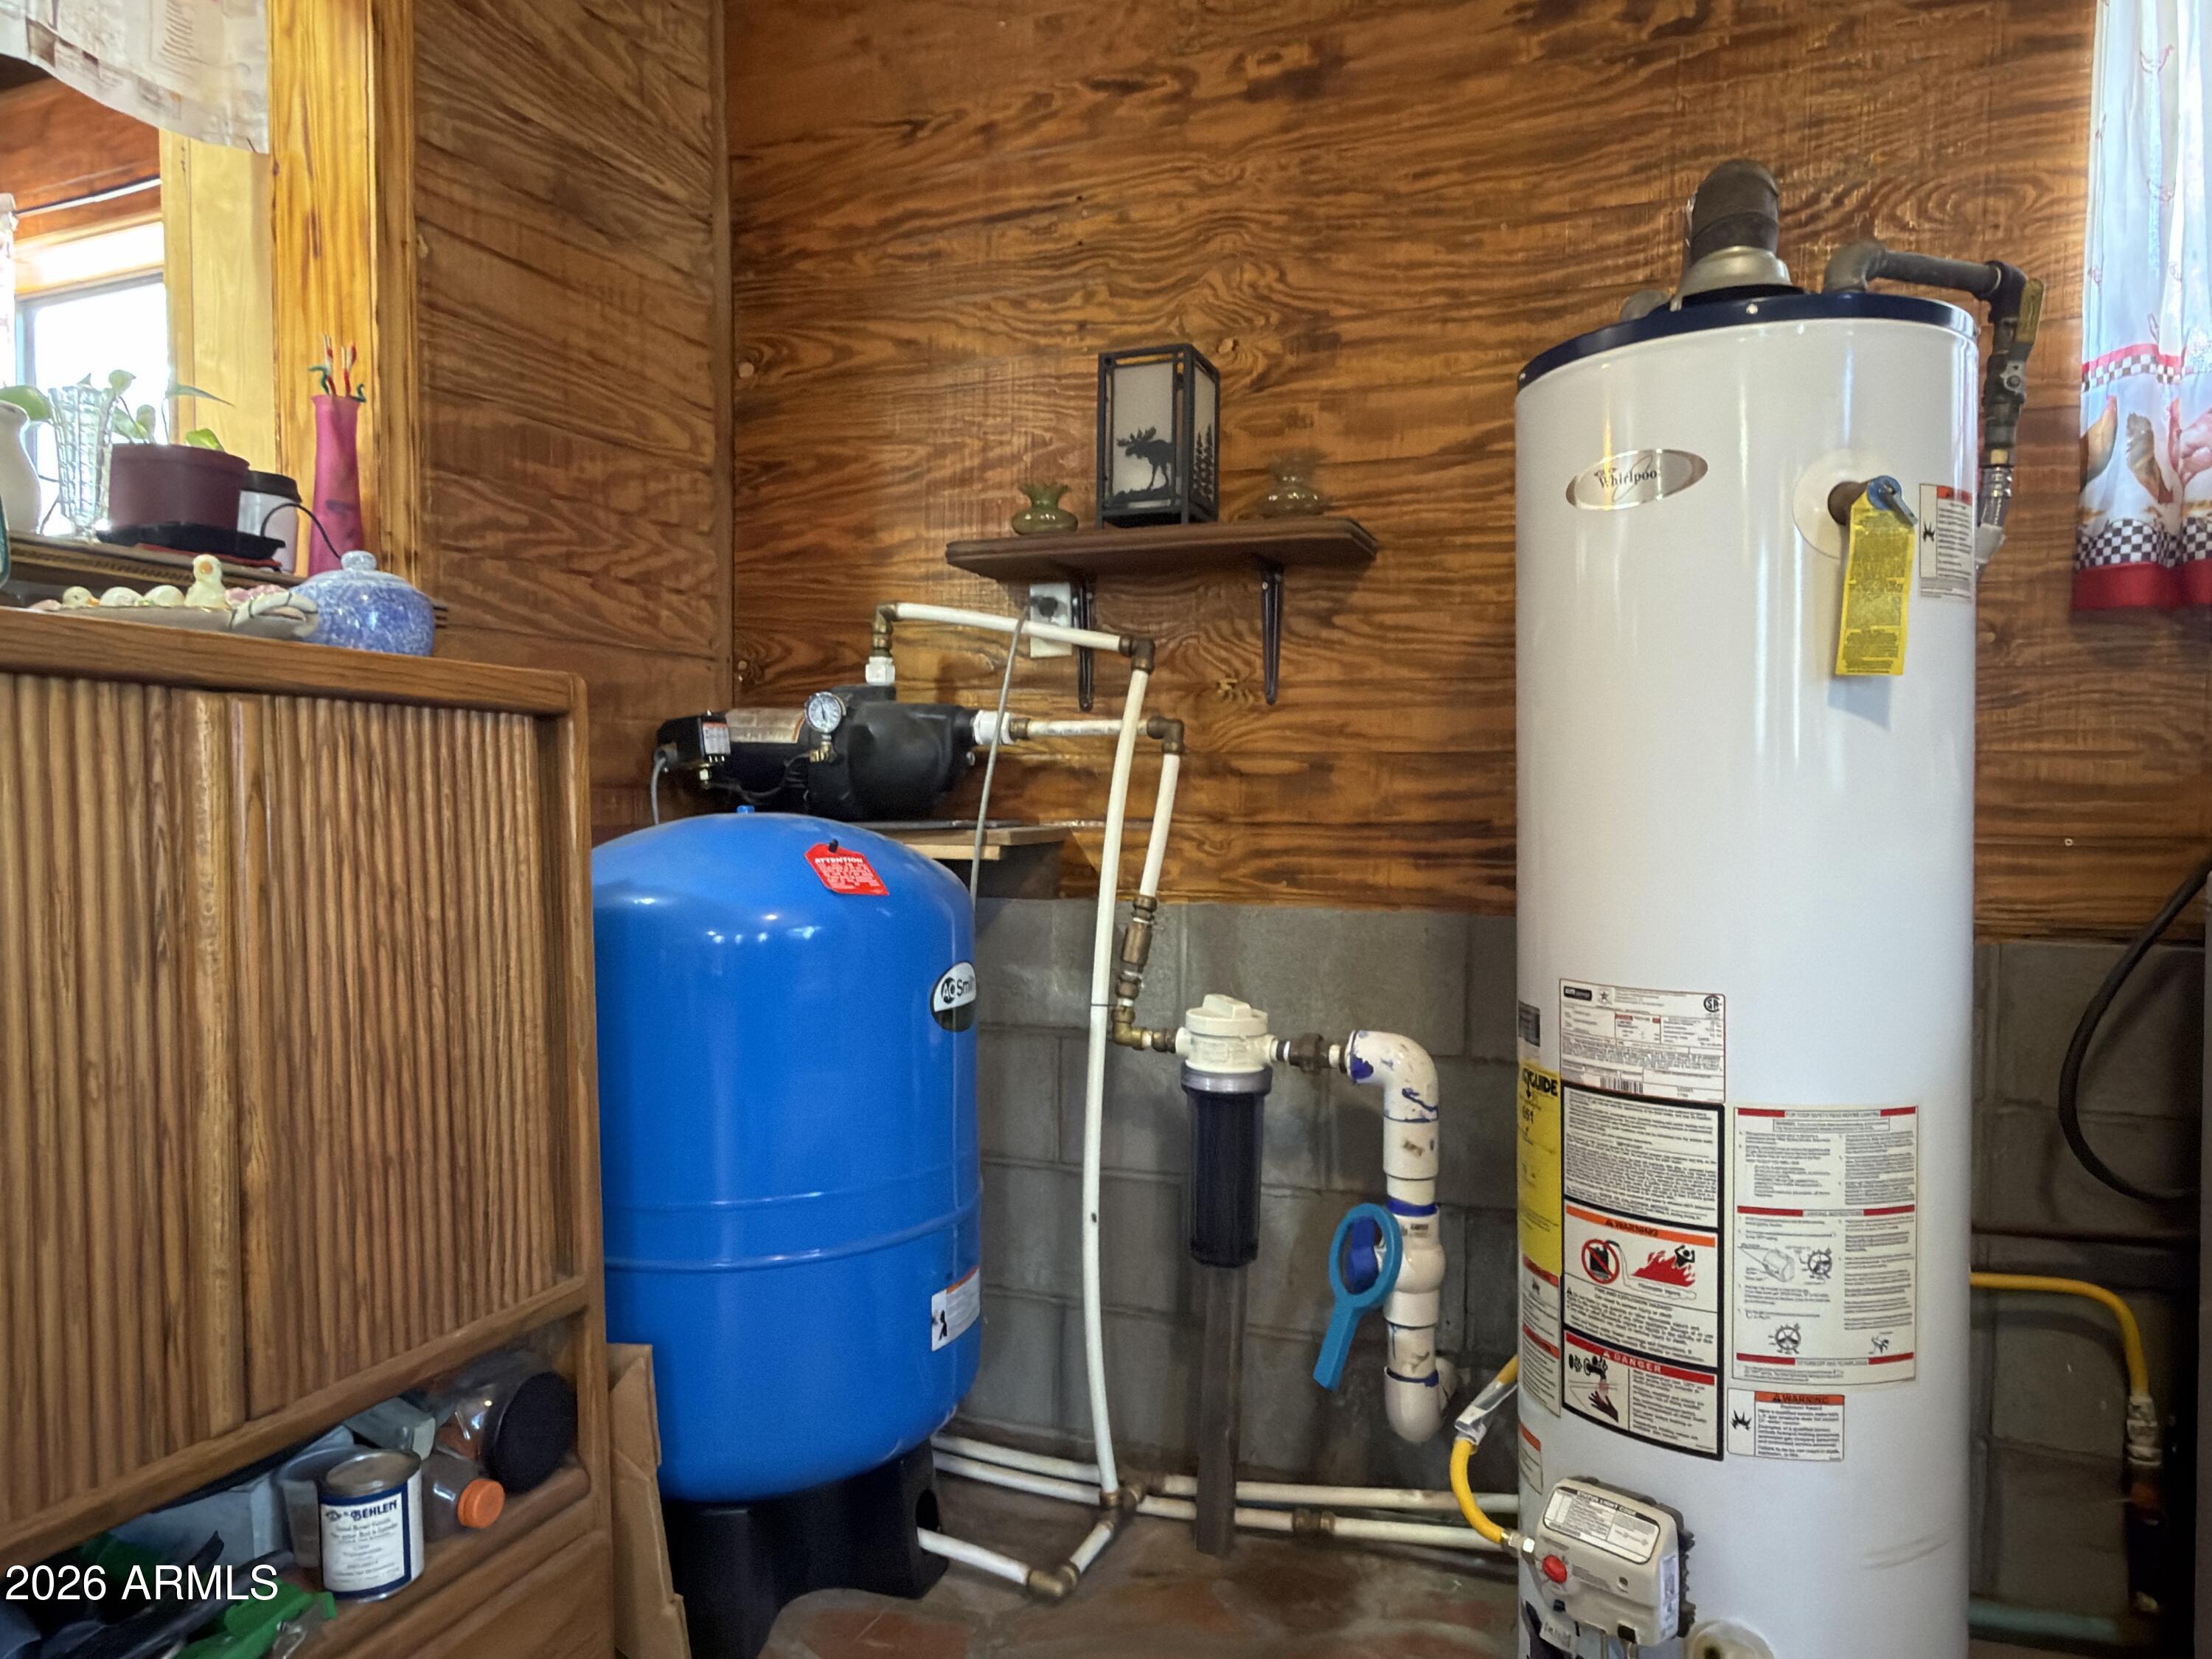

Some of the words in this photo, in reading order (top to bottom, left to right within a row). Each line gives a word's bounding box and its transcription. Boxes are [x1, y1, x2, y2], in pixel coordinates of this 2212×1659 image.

[1594, 466, 1661, 490] Whirlpoo
[814, 856, 863, 865] ATTENTION
[1615, 1220, 1658, 1237] WARNING
[1613, 1354, 1661, 1373] DANGER
[1781, 1394, 1829, 1405] WARNING
[350, 1500, 397, 1521] BEHLEN
